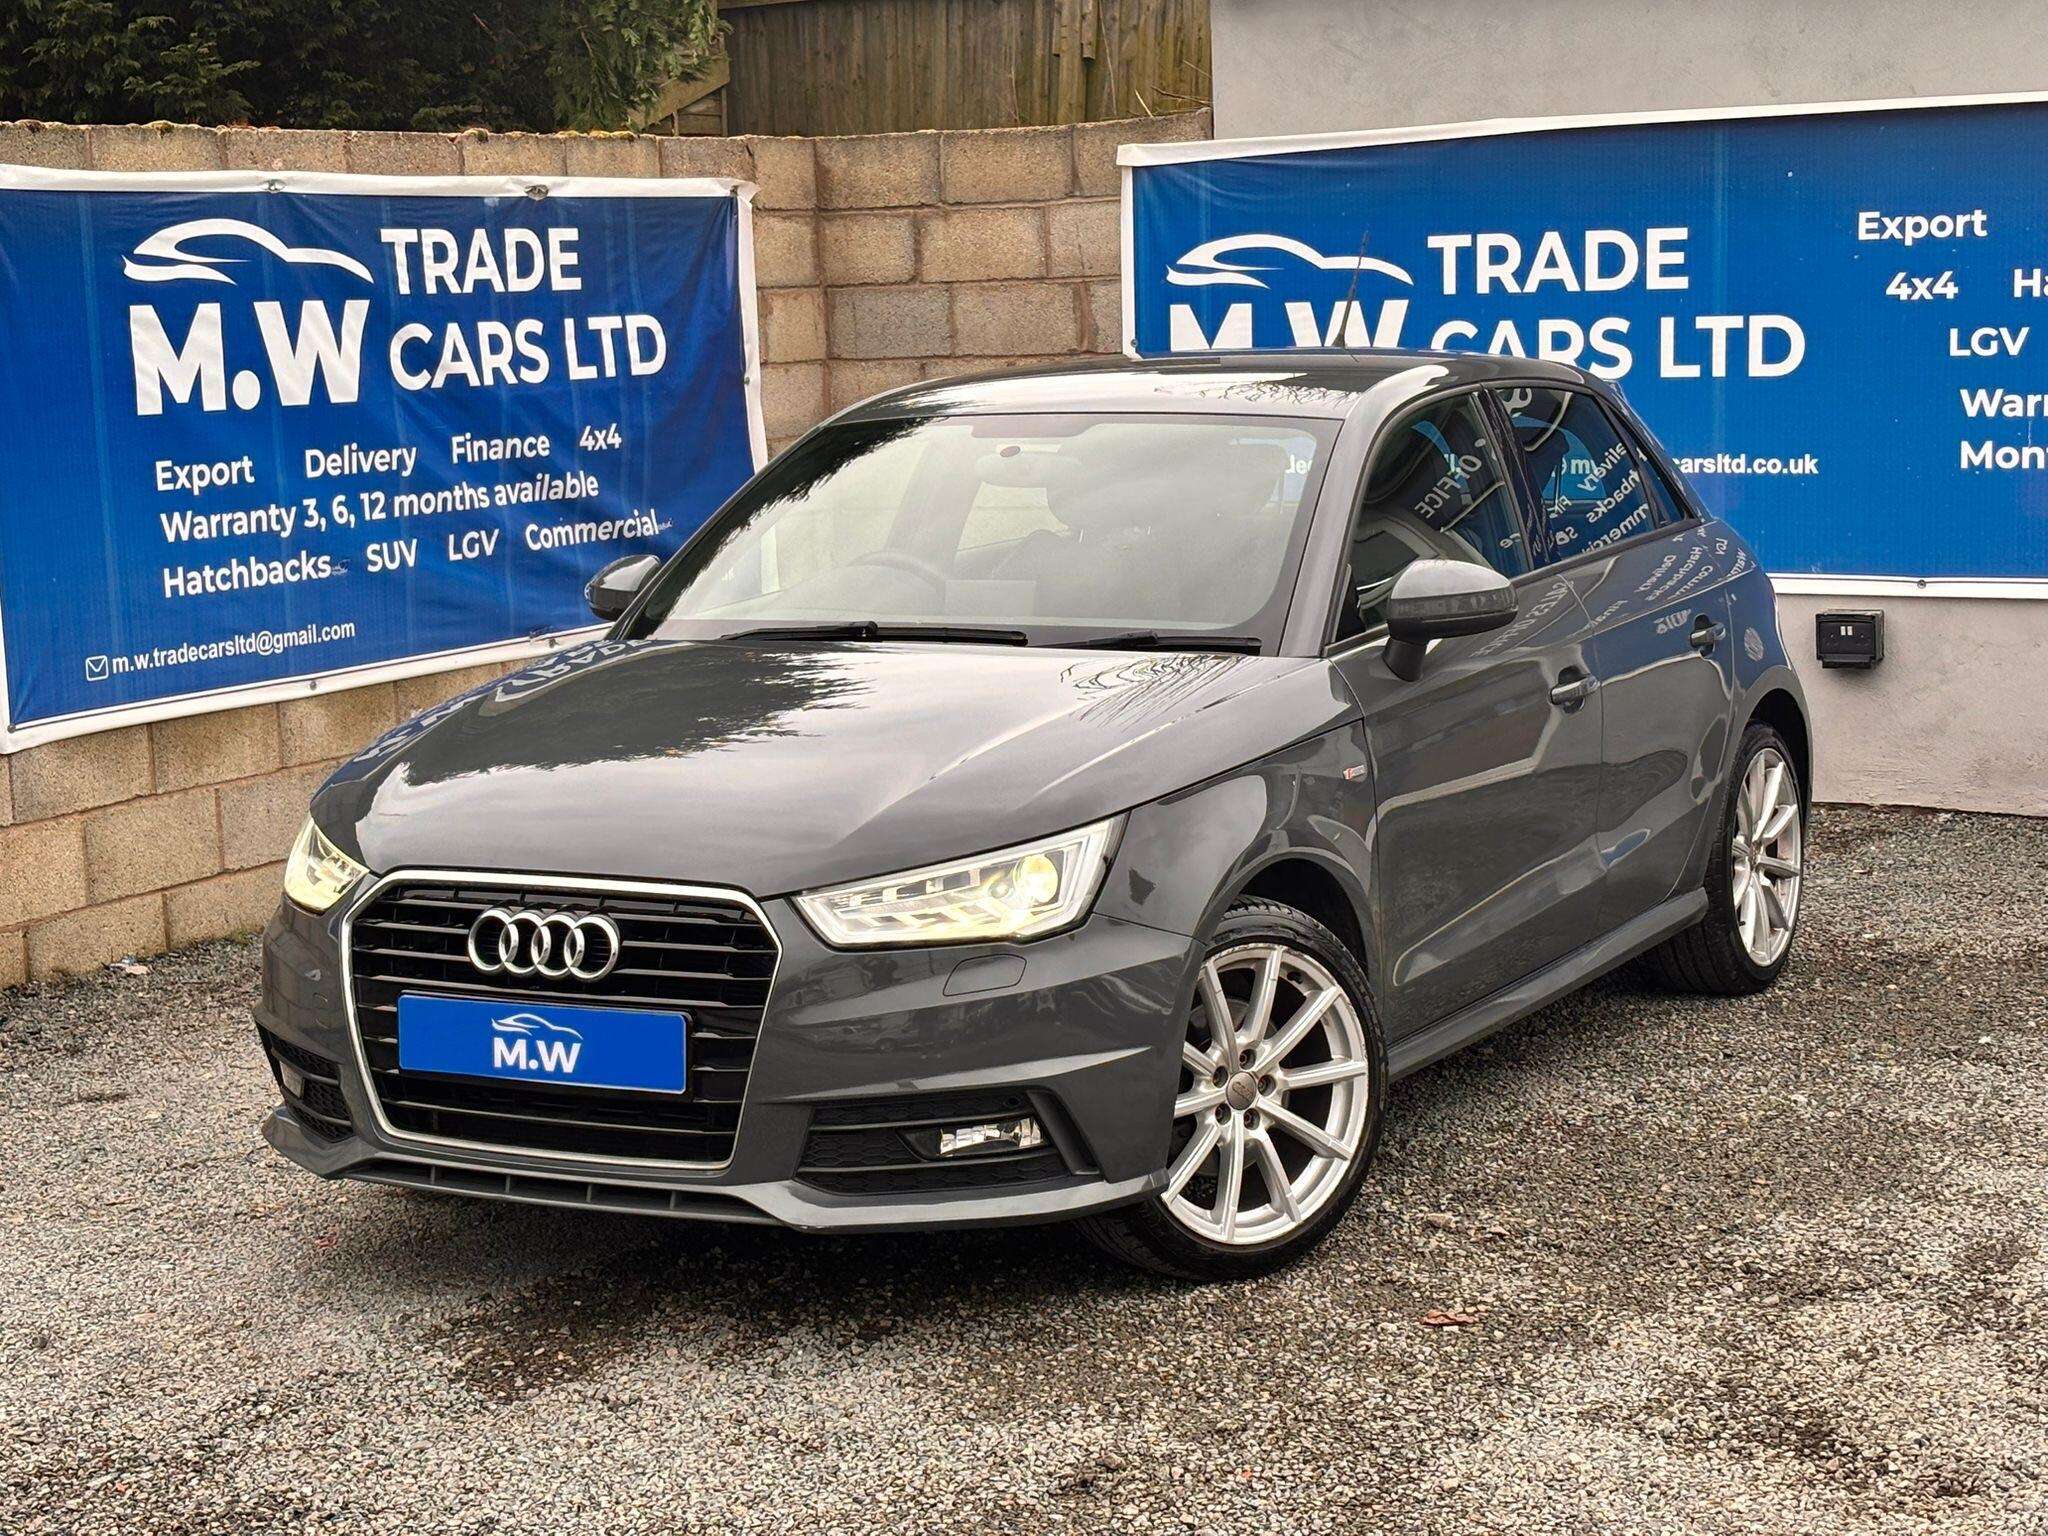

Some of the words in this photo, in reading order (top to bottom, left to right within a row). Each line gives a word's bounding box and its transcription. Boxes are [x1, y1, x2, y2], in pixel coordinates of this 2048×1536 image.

[1858, 209, 1989, 246] Export
[380, 227, 582, 295] TRADE
[1427, 227, 1689, 295] TRADE
[1885, 271, 1959, 300] 4x4
[129, 300, 370, 415] M.W
[390, 320, 550, 391] CARS
[564, 314, 667, 380] LTD
[1660, 315, 1805, 378] LTD
[1949, 327, 2029, 357] LGV
[156, 456, 255, 496] Export
[305, 442, 416, 479] Delivery
[452, 431, 551, 465] Finance
[579, 423, 623, 452] 4x4
[1960, 441, 2048, 470] Mon
[160, 503, 297, 544] Warranty
[302, 497, 327, 532] 3,
[332, 494, 356, 529] 6,
[361, 490, 387, 521] 12
[394, 484, 491, 518] months
[494, 470, 600, 508] available
[163, 551, 331, 599] Hatchbacks
[365, 538, 418, 573] SUV
[448, 529, 500, 562] LGV
[525, 507, 659, 552] Commercial
[112, 622, 356, 675] m.w.tradecarsltd@gmail.com
[493, 1037, 582, 1074] M.W
